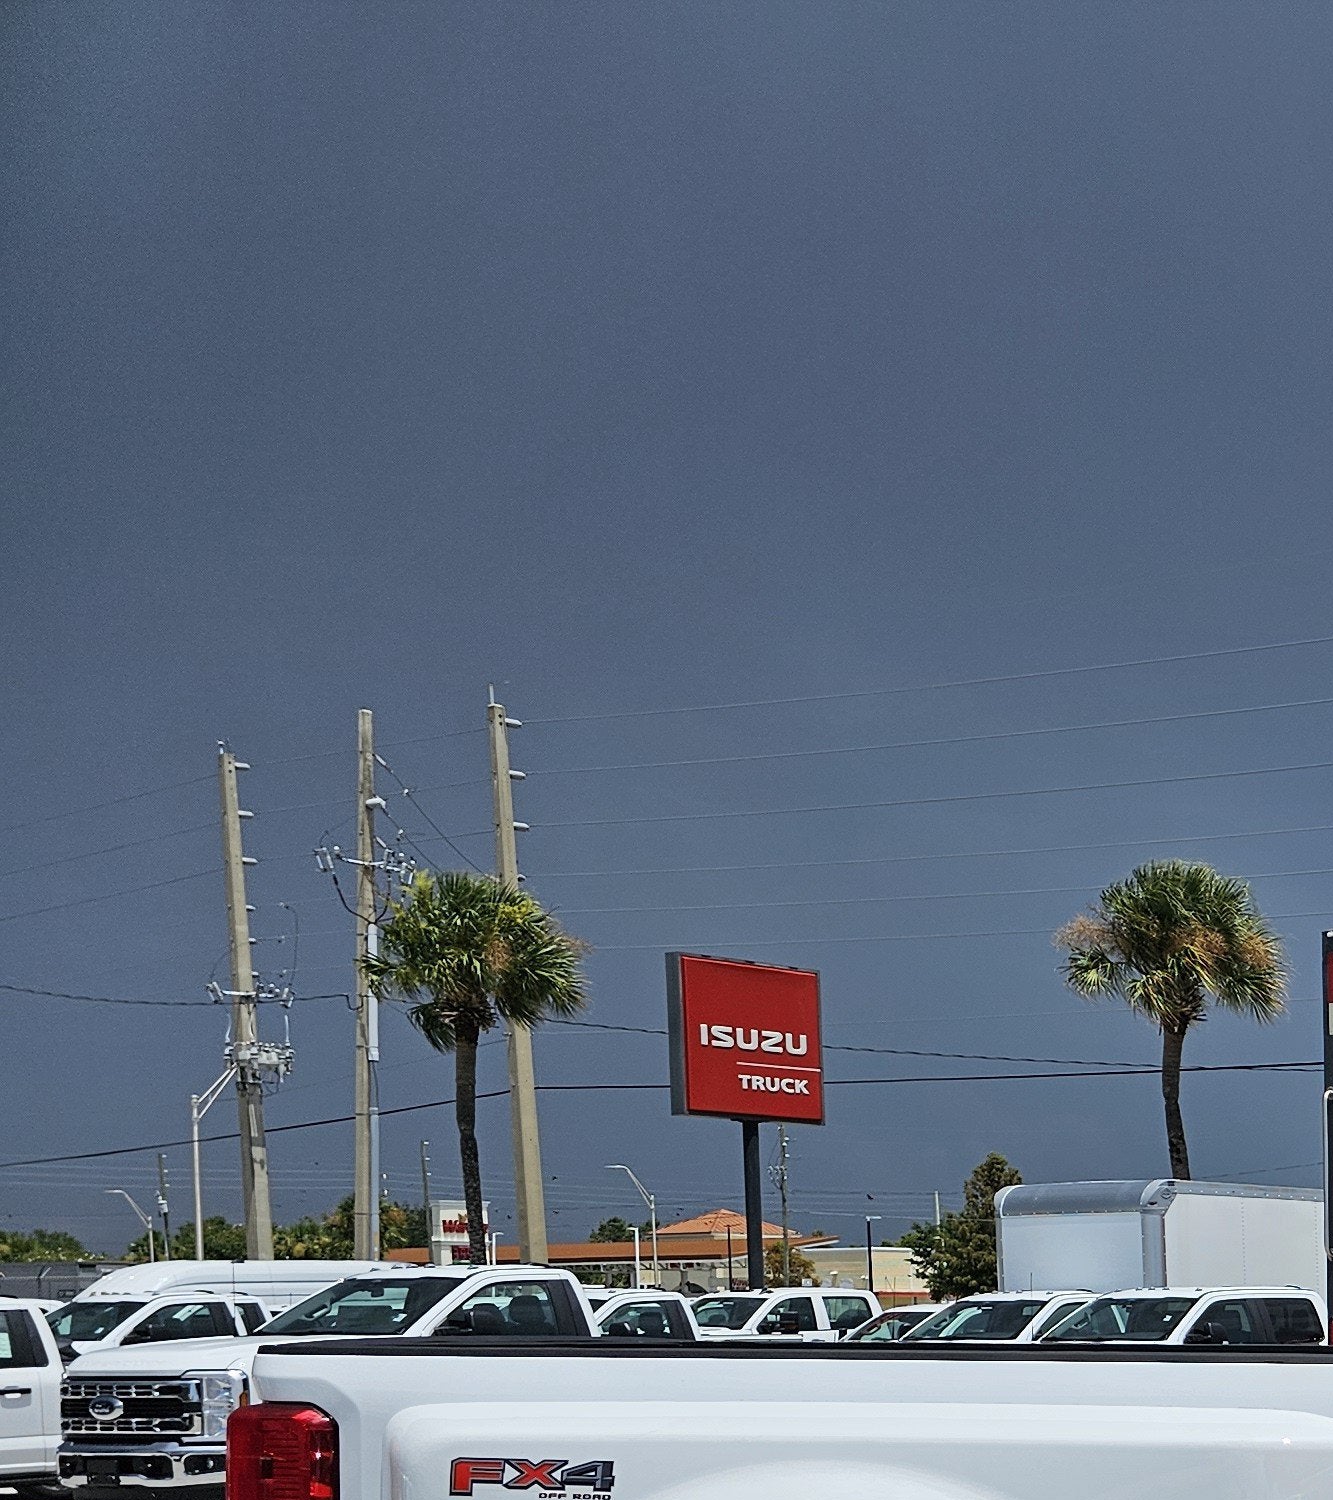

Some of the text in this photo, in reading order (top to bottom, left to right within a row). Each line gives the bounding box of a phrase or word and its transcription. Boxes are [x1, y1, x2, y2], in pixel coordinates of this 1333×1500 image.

[700, 1023, 808, 1056] ISUZU
[737, 1074, 810, 1095] TRUCK
[449, 1457, 616, 1497] FX4
[538, 1492, 612, 1500] OFF ROAD
